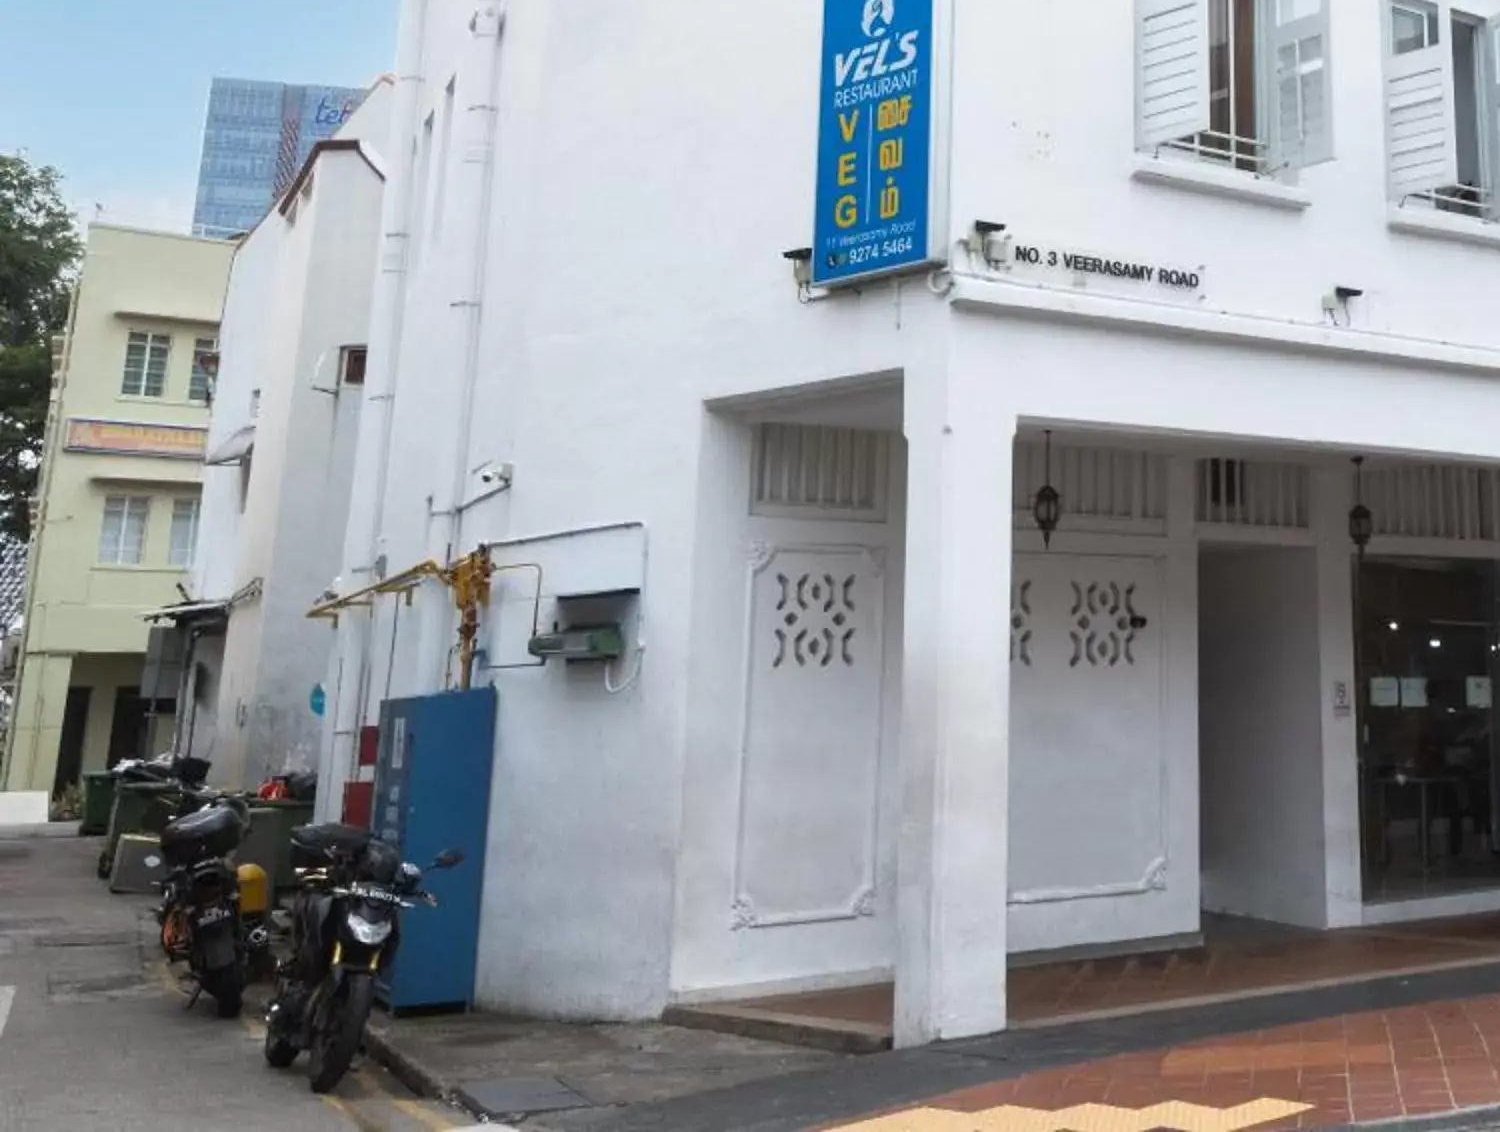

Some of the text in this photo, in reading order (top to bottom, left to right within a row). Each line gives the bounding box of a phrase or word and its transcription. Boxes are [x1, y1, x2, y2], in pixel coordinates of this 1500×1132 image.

[834, 29, 919, 87] VEL'S
[834, 68, 918, 109] RESTAURANT
[848, 242, 880, 266] 9274
[1015, 245, 1200, 289] NO. 3 VEERASAMY ROAD
